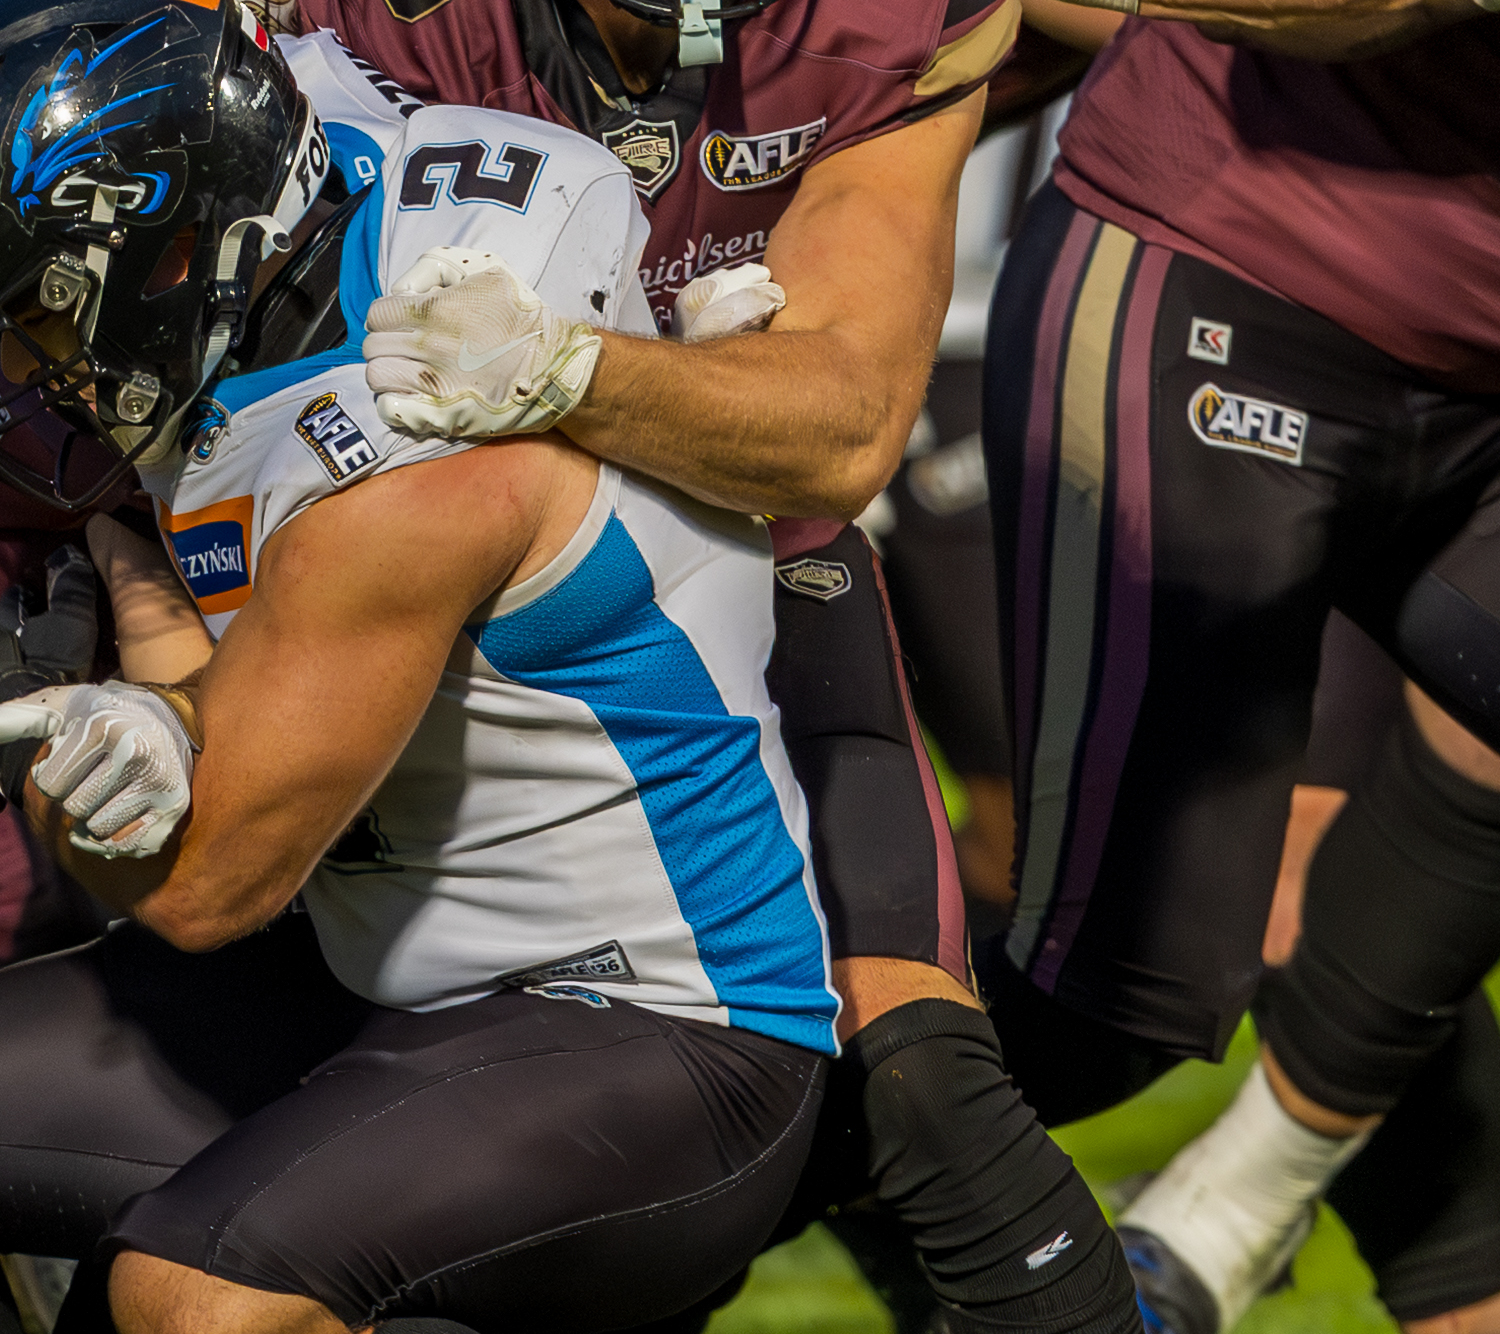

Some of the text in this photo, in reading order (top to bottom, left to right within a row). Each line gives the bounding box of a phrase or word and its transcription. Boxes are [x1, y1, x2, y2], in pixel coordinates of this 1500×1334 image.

[398, 139, 549, 216] 2
[723, 126, 821, 178] AFLE
[301, 404, 376, 475] AFLE
[1208, 397, 1302, 451] AFLE
[590, 958, 621, 975] '26
